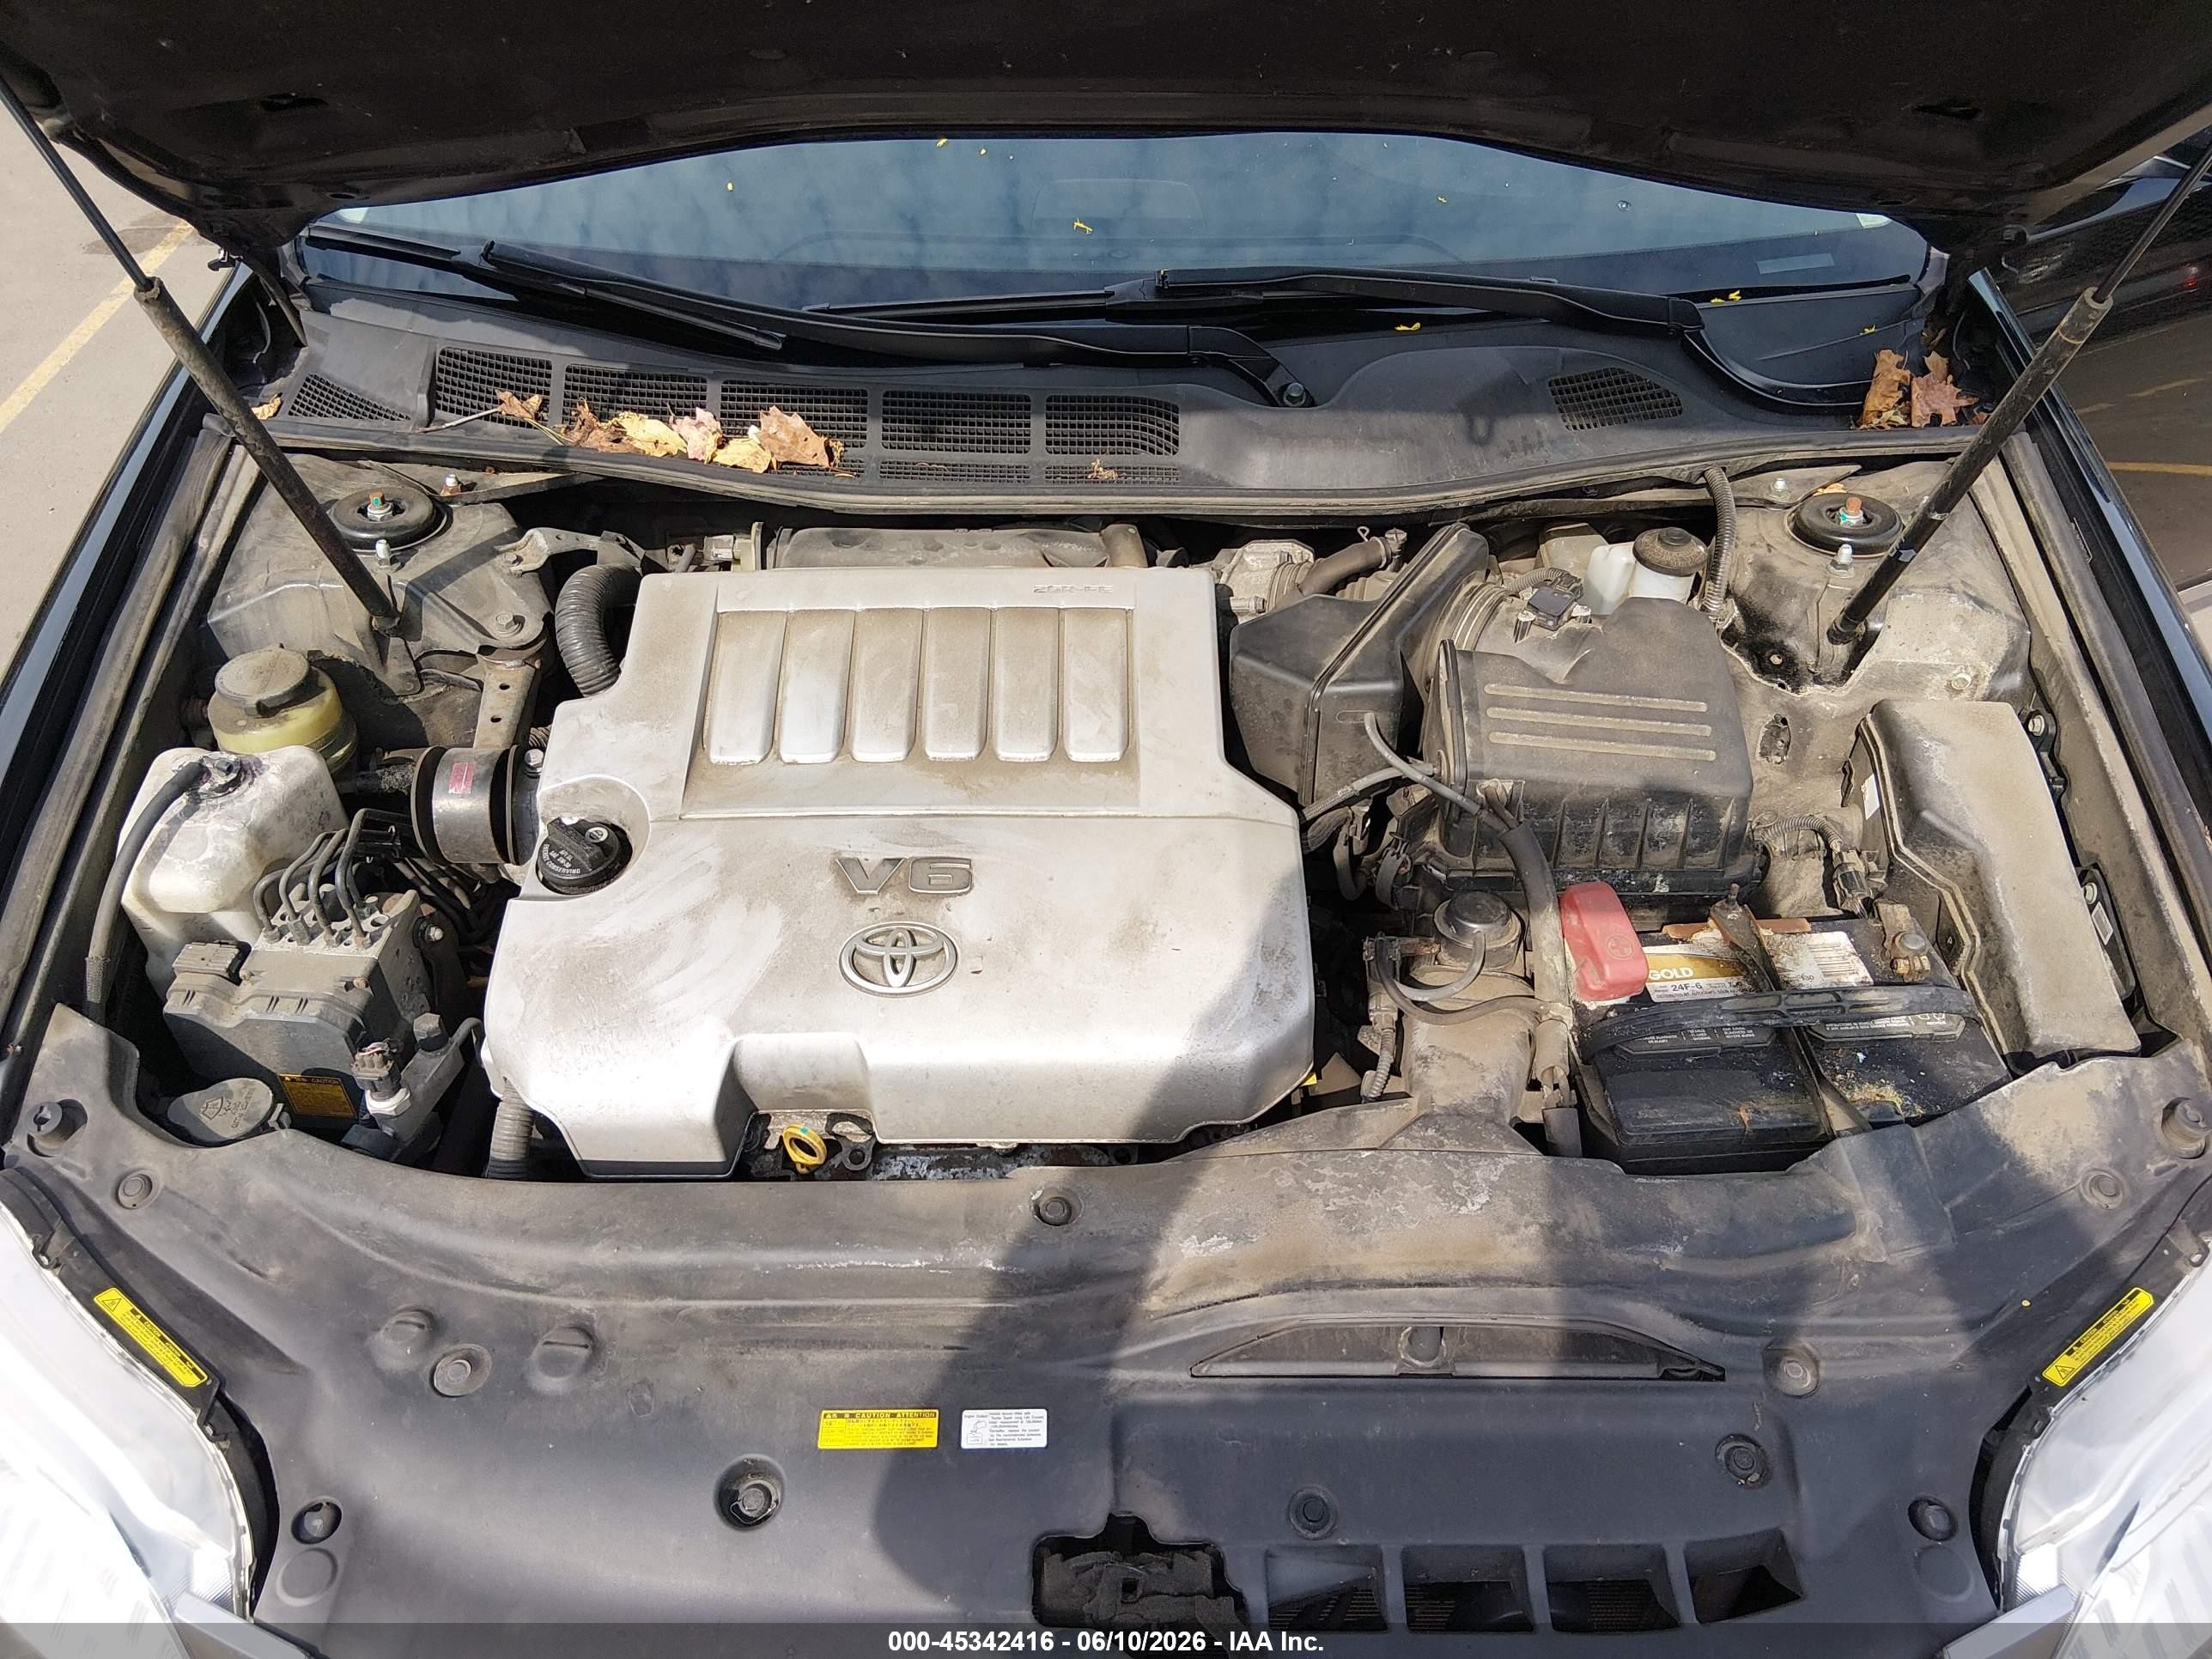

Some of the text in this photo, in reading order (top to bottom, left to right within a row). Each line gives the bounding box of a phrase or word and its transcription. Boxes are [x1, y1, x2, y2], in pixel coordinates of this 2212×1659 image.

[546, 860, 581, 874] CONSERVING
[834, 857, 973, 895] V6
[1648, 967, 1694, 981] GOLD
[1670, 981, 1703, 992] 24F-6
[143, 1321, 161, 1337] CAUTION
